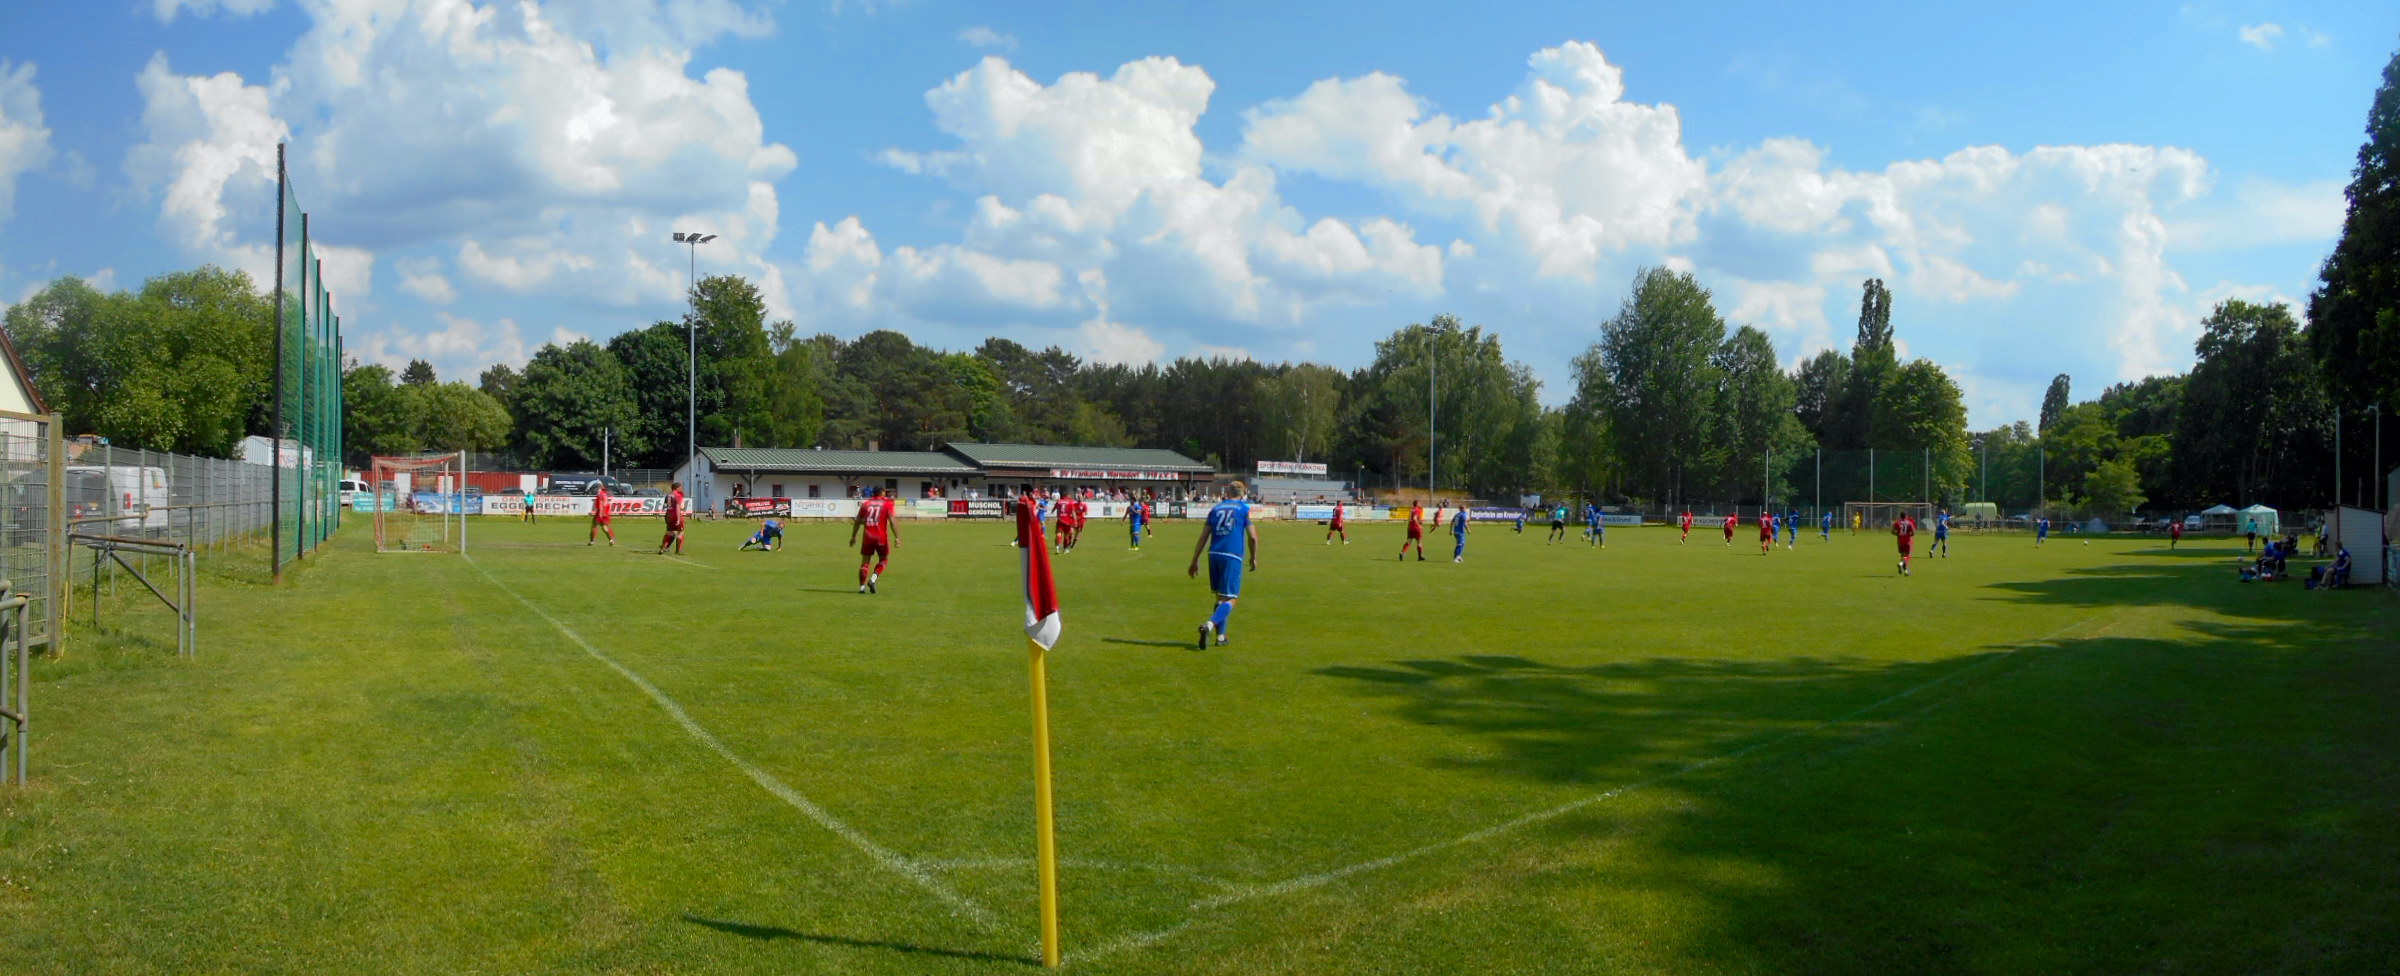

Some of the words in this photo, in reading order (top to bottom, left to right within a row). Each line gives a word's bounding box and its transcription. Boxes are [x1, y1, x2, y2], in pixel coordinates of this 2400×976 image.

[491, 502, 578, 510] EGGERECHT
[867, 506, 880, 522] 27
[1216, 510, 1233, 531] 24
